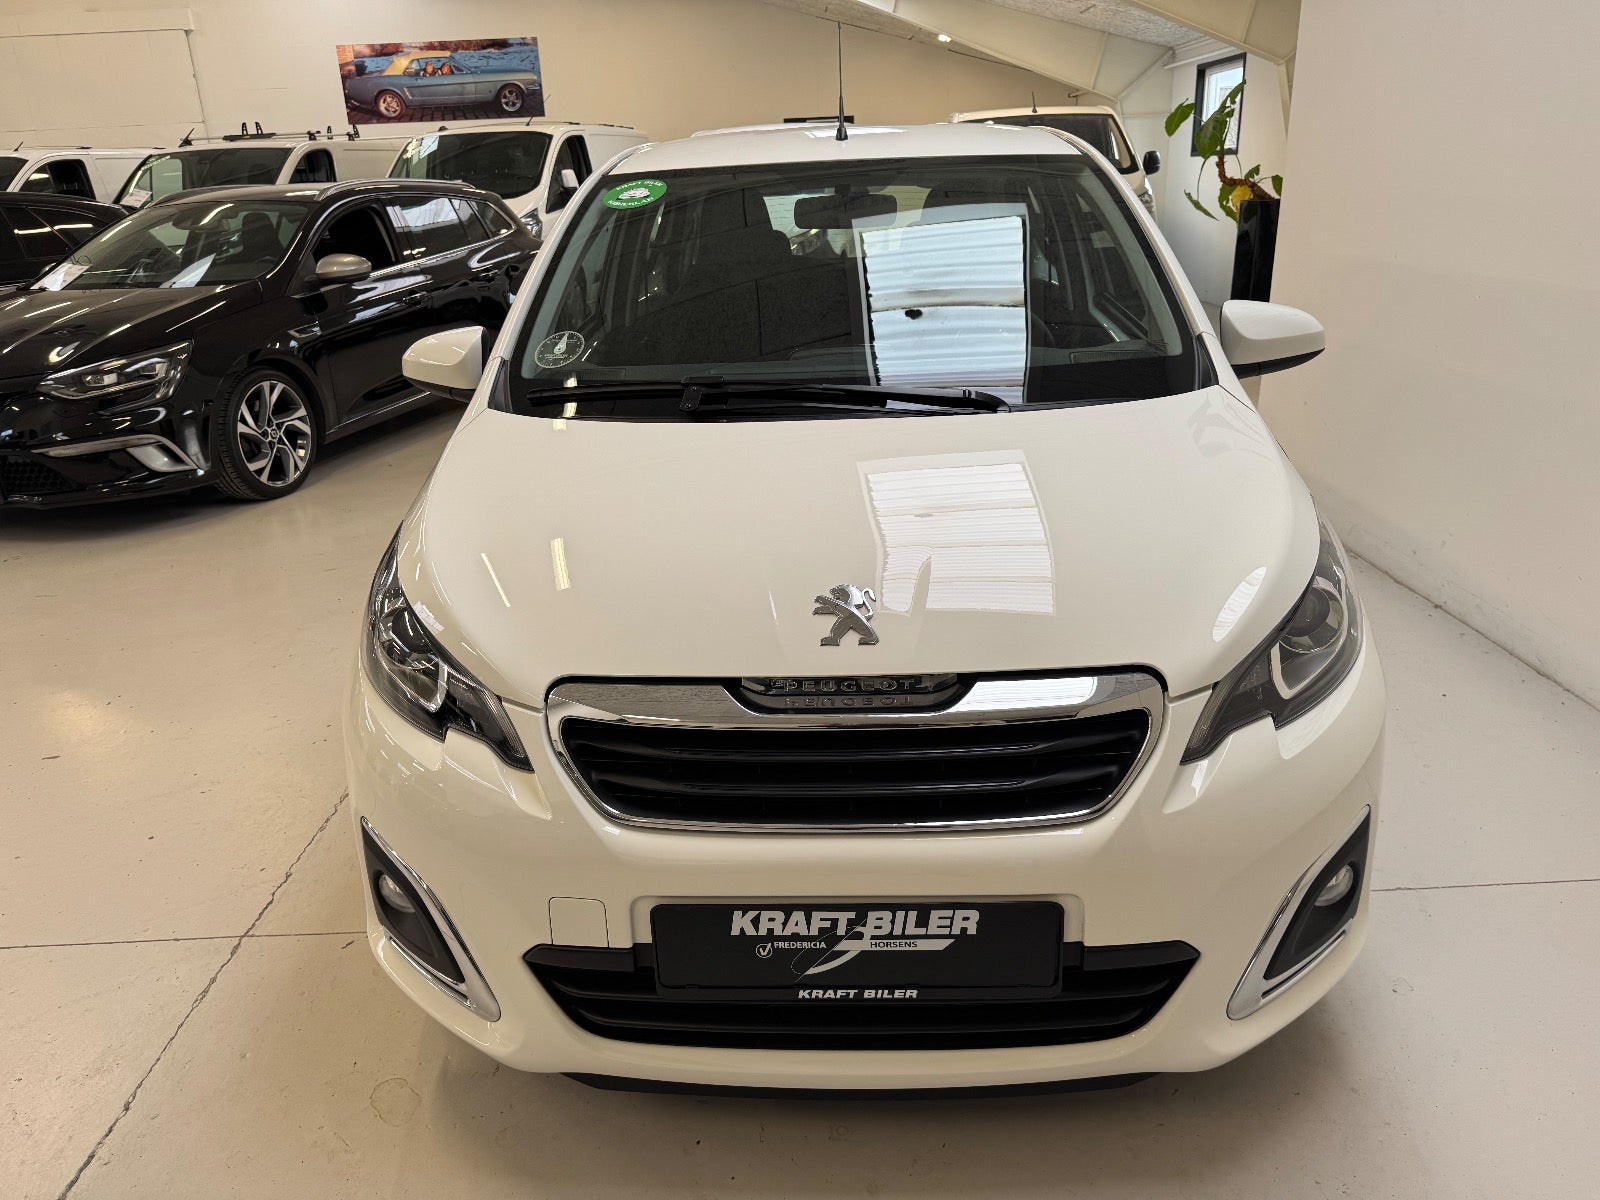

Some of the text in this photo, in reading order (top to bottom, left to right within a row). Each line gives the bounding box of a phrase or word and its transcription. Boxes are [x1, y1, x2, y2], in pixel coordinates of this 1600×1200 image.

[783, 679, 915, 692] PEUGEOT
[730, 909, 980, 936] KRAFT BILER
[773, 940, 918, 950] FREDERICIA HORSENS
[798, 989, 918, 999] KRAFT BILER
